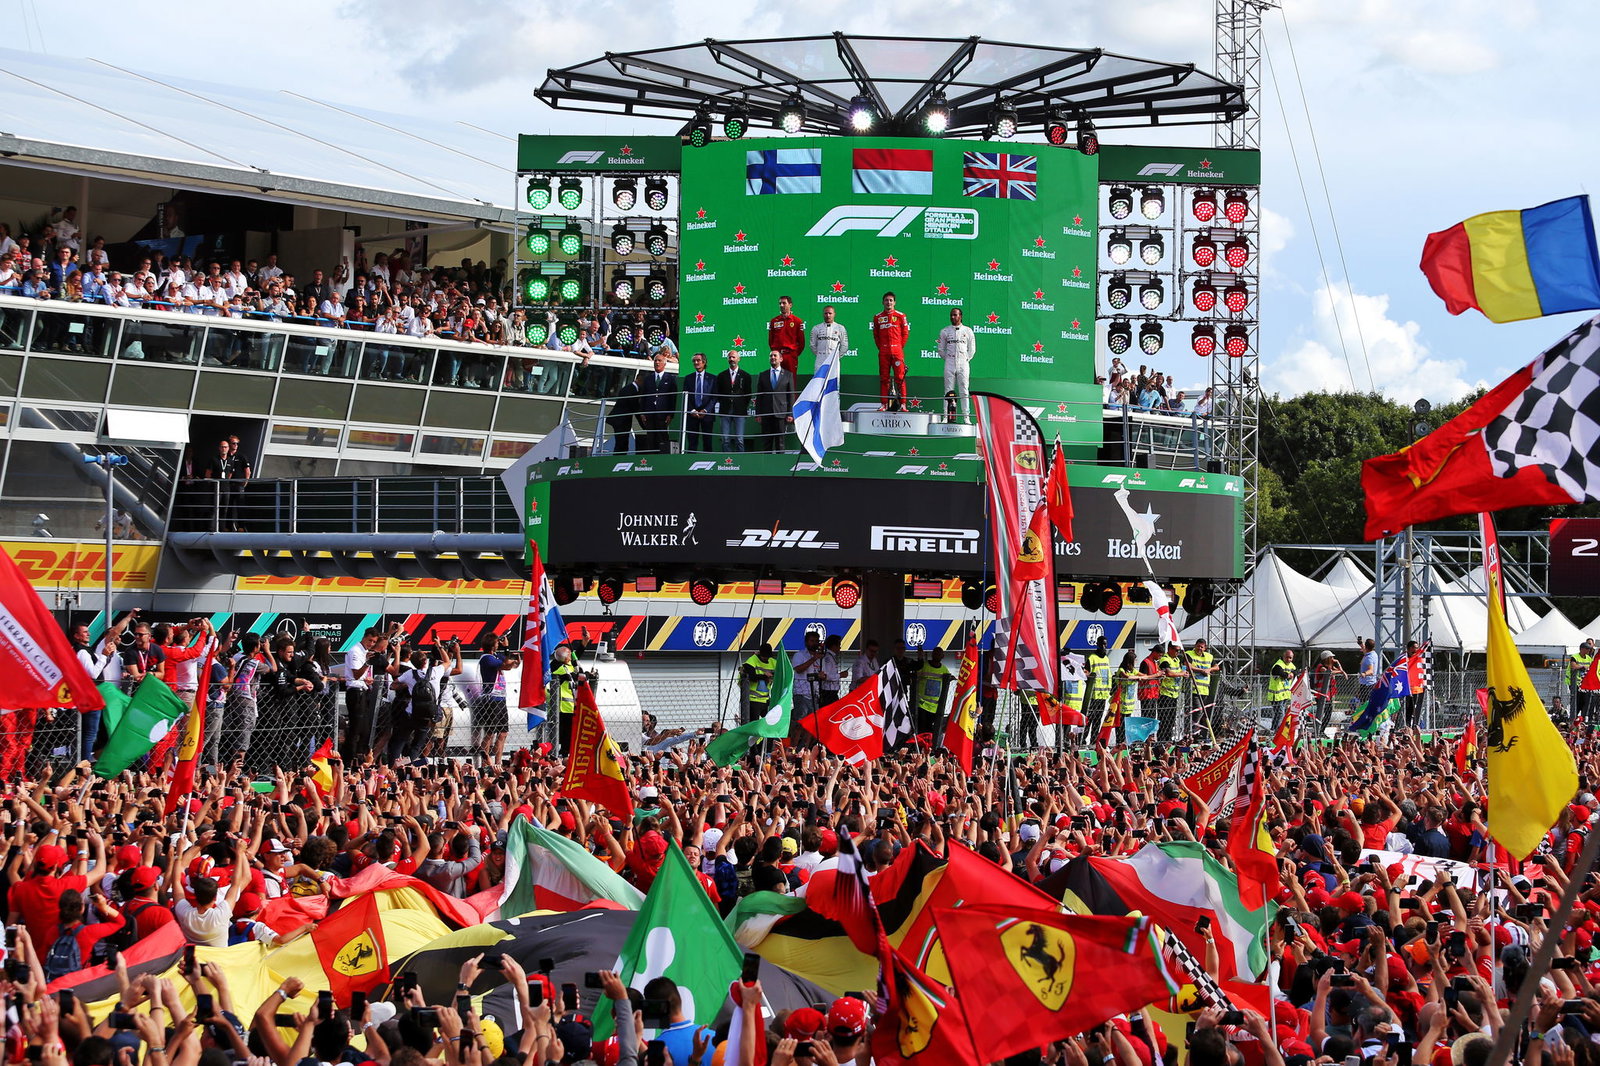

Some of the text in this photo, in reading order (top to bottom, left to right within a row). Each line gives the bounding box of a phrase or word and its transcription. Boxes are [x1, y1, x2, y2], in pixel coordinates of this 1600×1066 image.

[608, 156, 645, 165] Heineken
[1187, 170, 1224, 178] Heineken
[686, 219, 717, 231] Heineken
[1063, 226, 1092, 238] Heineken
[724, 243, 759, 253] Heineken
[1022, 248, 1056, 259] Heineken
[686, 271, 716, 282] Heineken
[767, 268, 808, 278] Heineken
[870, 268, 912, 278] Heineken
[974, 272, 1014, 282] Heineken
[1062, 278, 1091, 290] Heineken
[723, 295, 758, 306] Heineken
[817, 294, 859, 303] Heineken
[922, 296, 963, 306] Heineken
[1021, 301, 1055, 312] Heineken
[686, 324, 715, 334] Heineken
[973, 325, 1013, 335] Heineken
[1061, 330, 1090, 341] Heineken
[1020, 353, 1054, 364] Heineken
[871, 419, 912, 429] CARBON
[930, 469, 956, 477] Heineken
[617, 512, 679, 531] JOHNNIE
[621, 531, 678, 546] WALKER
[739, 528, 826, 549] DHL
[870, 525, 981, 554] PIRELLI
[13, 549, 128, 582] DHL
[0, 615, 57, 680] FERRARI CLUB
